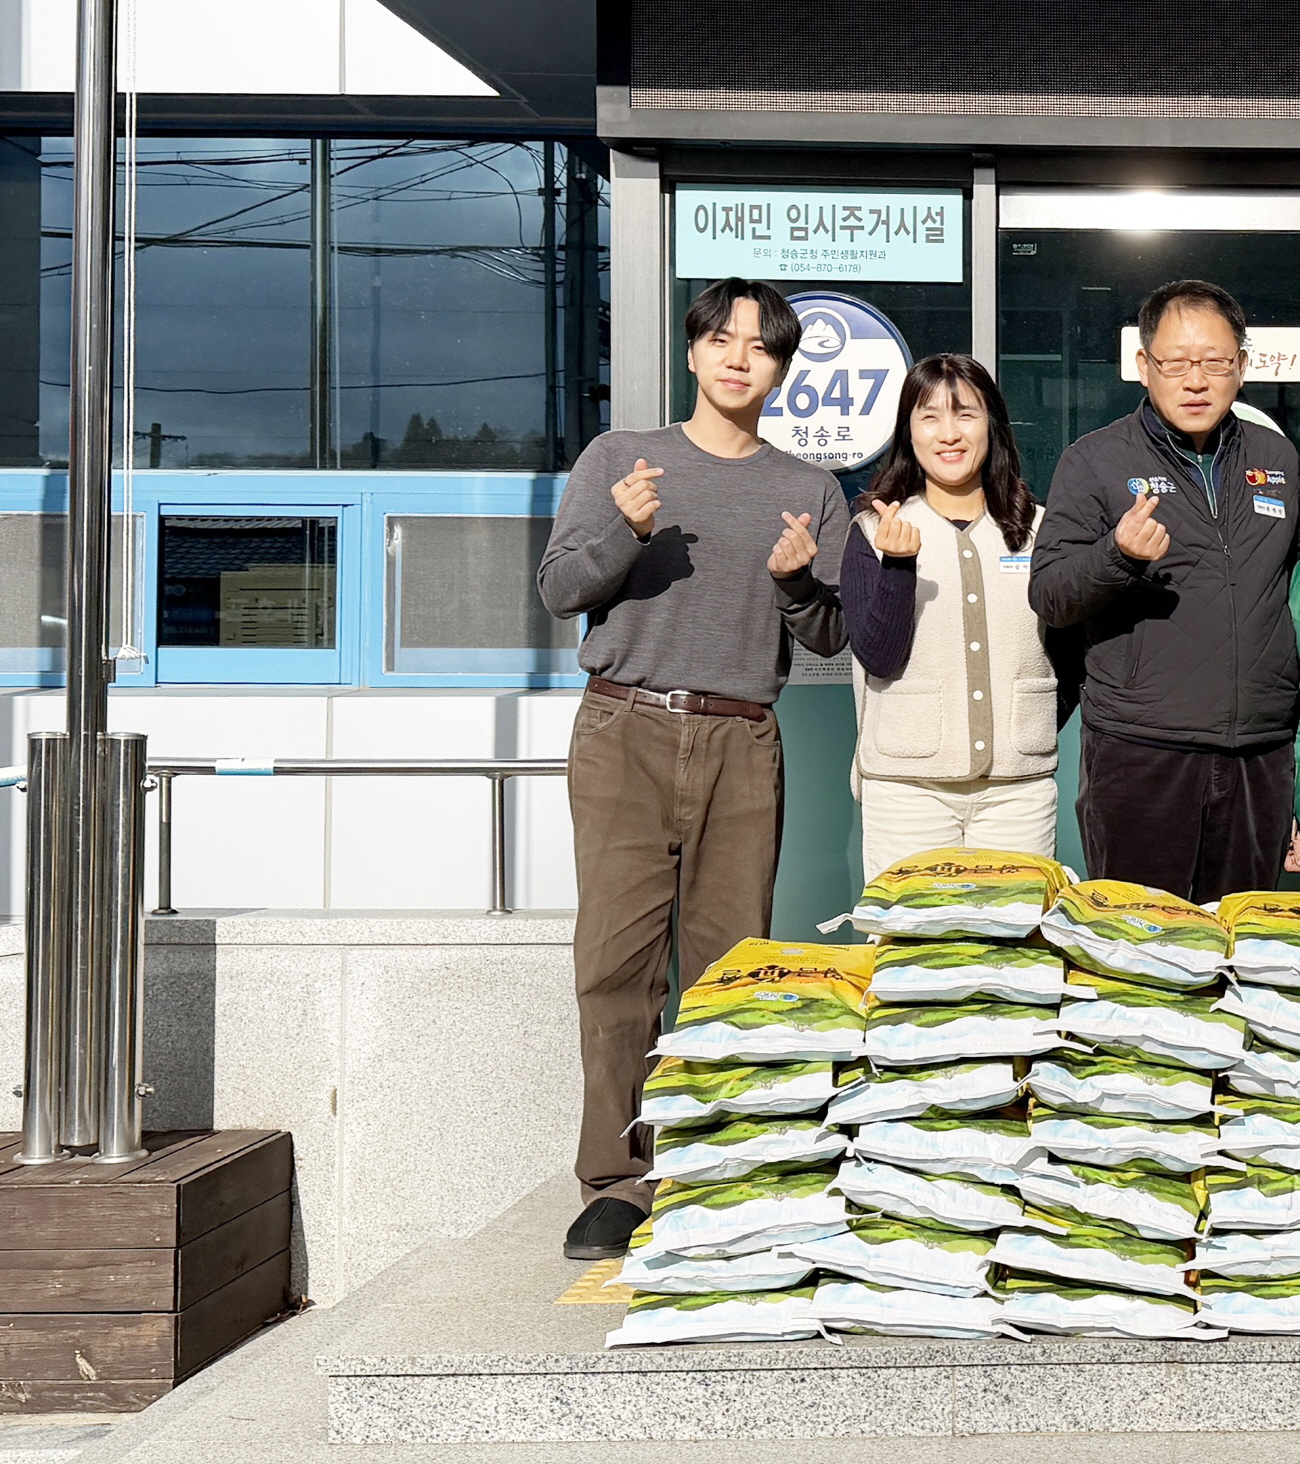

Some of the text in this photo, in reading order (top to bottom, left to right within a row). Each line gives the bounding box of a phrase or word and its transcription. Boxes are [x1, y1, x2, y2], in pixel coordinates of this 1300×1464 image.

[694, 202, 945, 243] 이재민 임시주거시설
[780, 249, 818, 259] 청송군청
[820, 249, 887, 260] 주민생활지원과
[791, 426, 854, 447] 청송로
